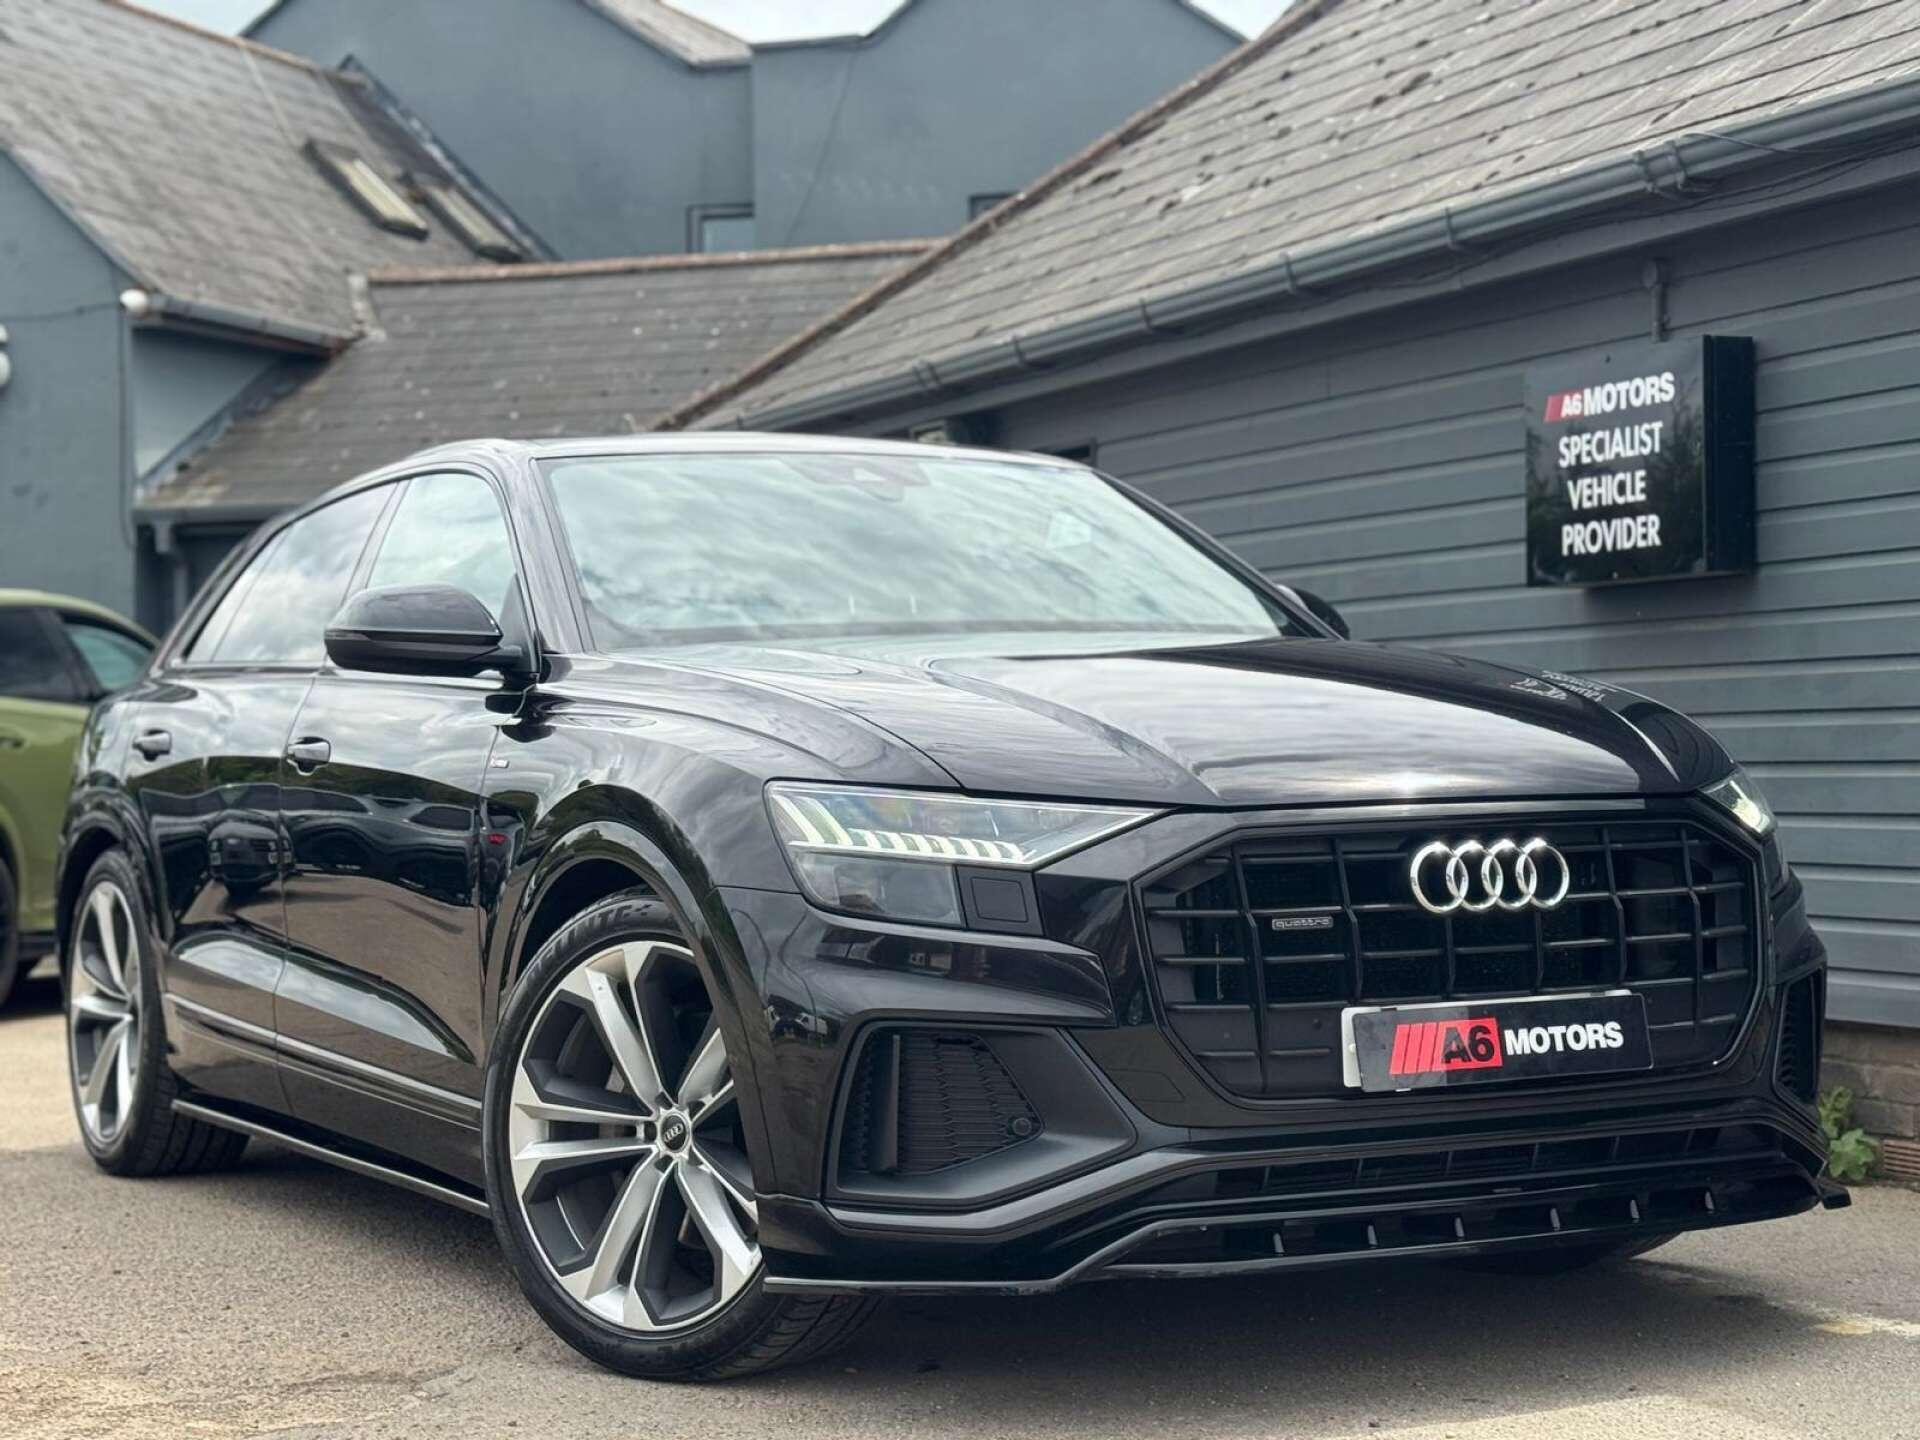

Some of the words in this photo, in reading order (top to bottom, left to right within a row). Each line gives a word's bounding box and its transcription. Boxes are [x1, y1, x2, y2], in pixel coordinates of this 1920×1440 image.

[1558, 421, 1663, 468] SPECIALIST
[1567, 470, 1647, 511] VEHICLE
[1561, 514, 1662, 556] PROVIDER
[1440, 1024, 1495, 1064] A6
[1504, 1020, 1624, 1056] MOTORS
